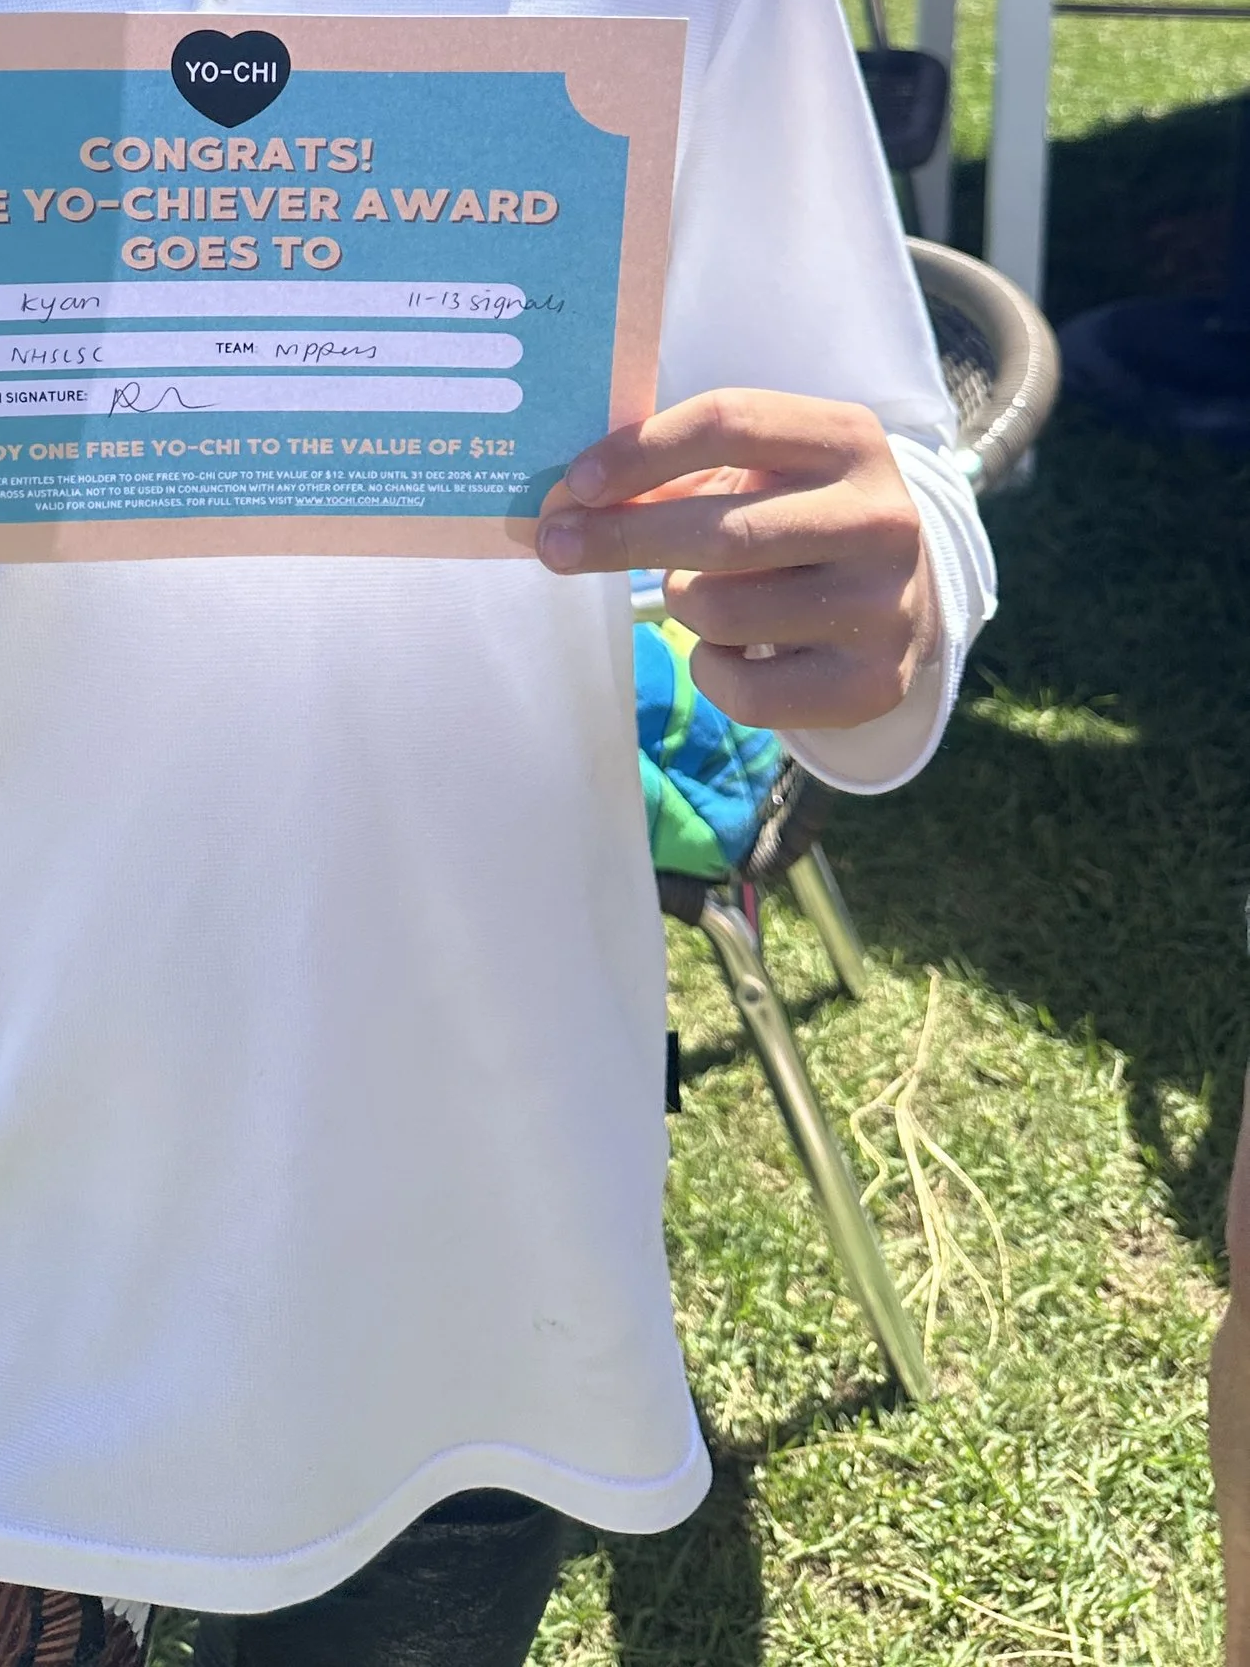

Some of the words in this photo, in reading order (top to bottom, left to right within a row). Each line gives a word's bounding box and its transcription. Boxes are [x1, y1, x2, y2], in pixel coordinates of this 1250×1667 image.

[185, 60, 277, 83] YO-CHI
[79, 136, 374, 172] CONGRATS!
[23, 187, 342, 223] YO-CHIEVER
[353, 188, 560, 225] AWARD
[121, 236, 259, 271] GOES
[272, 235, 343, 271] TO
[6, 390, 88, 404] SIGNATURE:
[29, 442, 80, 460] ONE
[86, 440, 144, 459] FREE
[151, 438, 240, 457] YO-CHI
[247, 438, 280, 455] TO
[287, 438, 334, 455] THE
[341, 438, 422, 455] VALUE
[428, 438, 462, 455] OF
[470, 436, 515, 459] $12!
[11, 476, 55, 486] ENTITLES
[57, 475, 76, 484] THE
[78, 474, 116, 484] HOLDER
[118, 473, 132, 483] TO
[134, 472, 154, 482] ONE
[156, 472, 180, 481] FREE
[181, 471, 216, 480] YO-CHI
[218, 471, 238, 480] CUP
[241, 471, 253, 480] TO
[255, 470, 274, 479] THE
[276, 470, 308, 479] VALUE
[310, 470, 323, 479] OF
[348, 470, 378, 480] VALID
[380, 470, 408, 480] UNTIL
[411, 471, 423, 480] 31
[426, 471, 445, 480] DEC
[447, 471, 472, 480] 2026
[474, 471, 487, 480] AT
[490, 471, 510, 480] ANY
[512, 472, 531, 480] YO-
[27, 488, 82, 498] AUSTRALIA.
[86, 487, 106, 496] NOT
[109, 486, 122, 495] TO
[123, 486, 135, 495] BE
[137, 485, 163, 495] USED
[165, 485, 176, 494] IN
[178, 484, 246, 494] CONJUNCTION
[249, 483, 274, 493] WITH
[276, 483, 297, 493] ANY
[298, 483, 331, 492] OTHER
[368, 483, 383, 492] NO
[385, 483, 426, 492] CHANGE
[427, 483, 452, 493] WILL
[454, 484, 466, 493] BE
[508, 485, 531, 494] NOT
[35, 502, 65, 511] VALID
[66, 501, 86, 510] FOR
[87, 500, 122, 510] ONLINE
[125, 498, 184, 508] PURCHASES.
[186, 497, 206, 507] FOR
[208, 497, 231, 506] FULL
[234, 496, 266, 505] TERMS
[268, 496, 293, 505] VISIT
